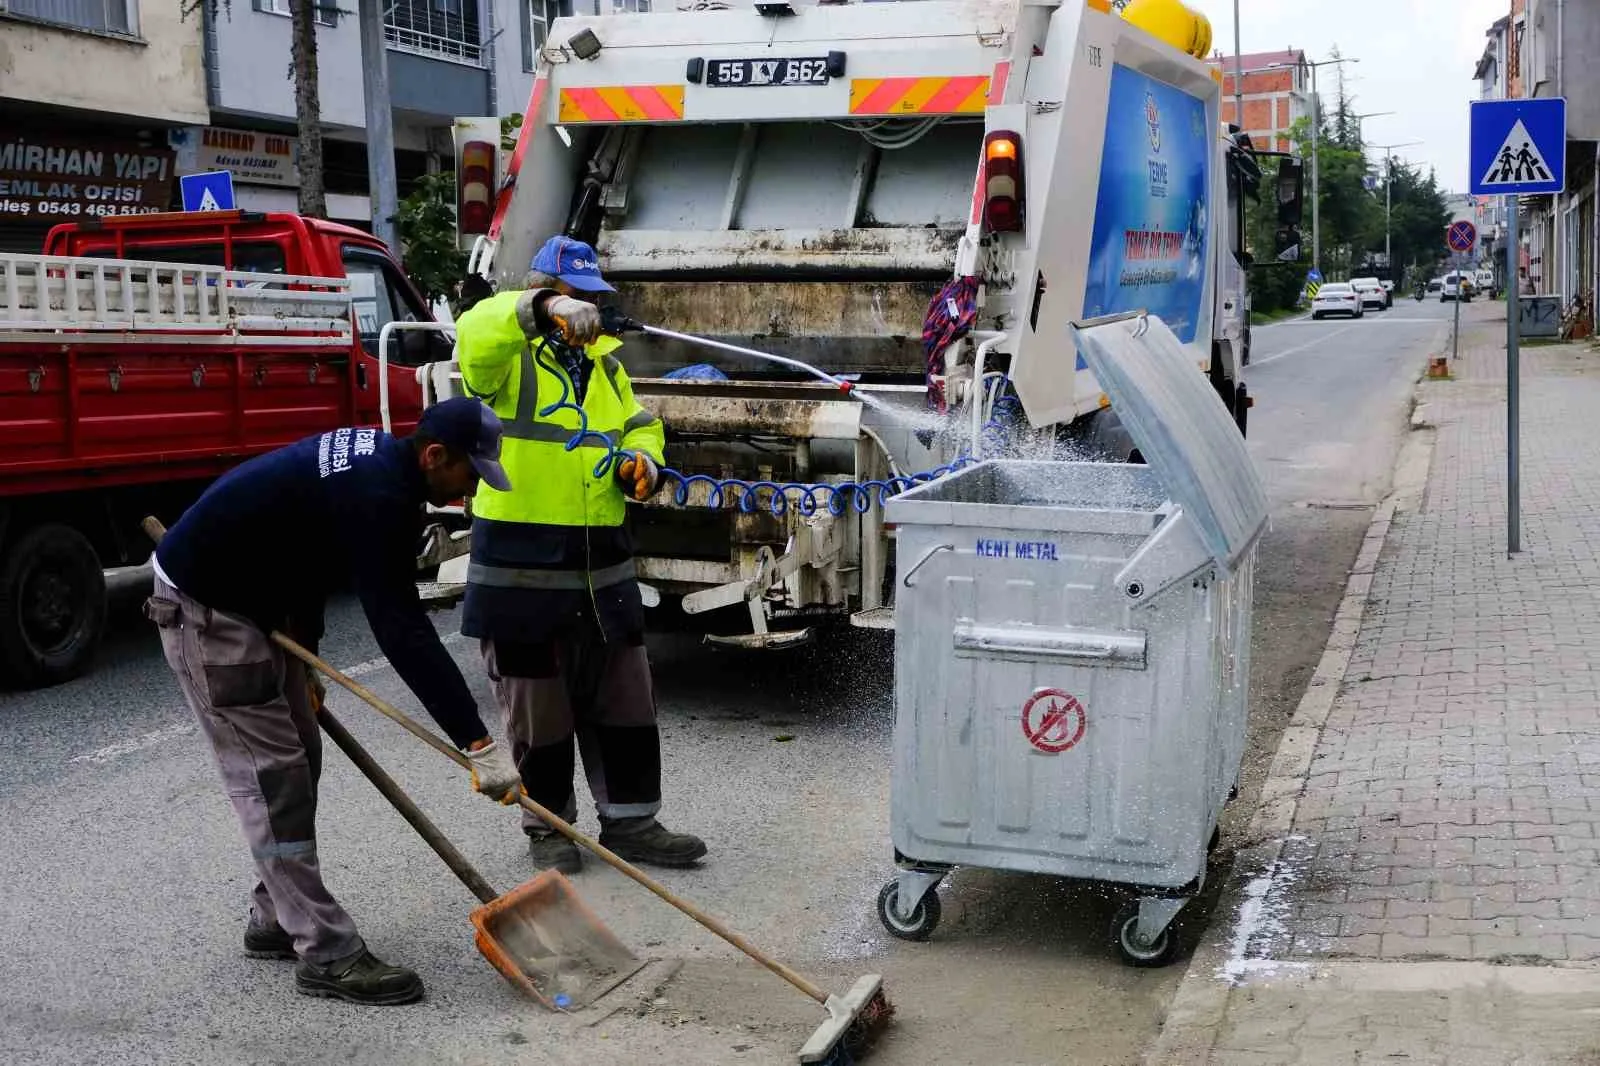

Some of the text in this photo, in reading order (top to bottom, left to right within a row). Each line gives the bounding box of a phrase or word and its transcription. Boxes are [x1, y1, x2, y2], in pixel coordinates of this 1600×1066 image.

[718, 63, 743, 83] 55
[786, 61, 826, 82] 662
[113, 152, 169, 181] YAPI
[0, 178, 142, 203] EMLAK OFİSİ
[0, 199, 31, 216] leş
[38, 201, 81, 215] 0543
[85, 203, 116, 216] 463
[354, 428, 376, 456] TERME
[976, 539, 1059, 561] KENT METAL
